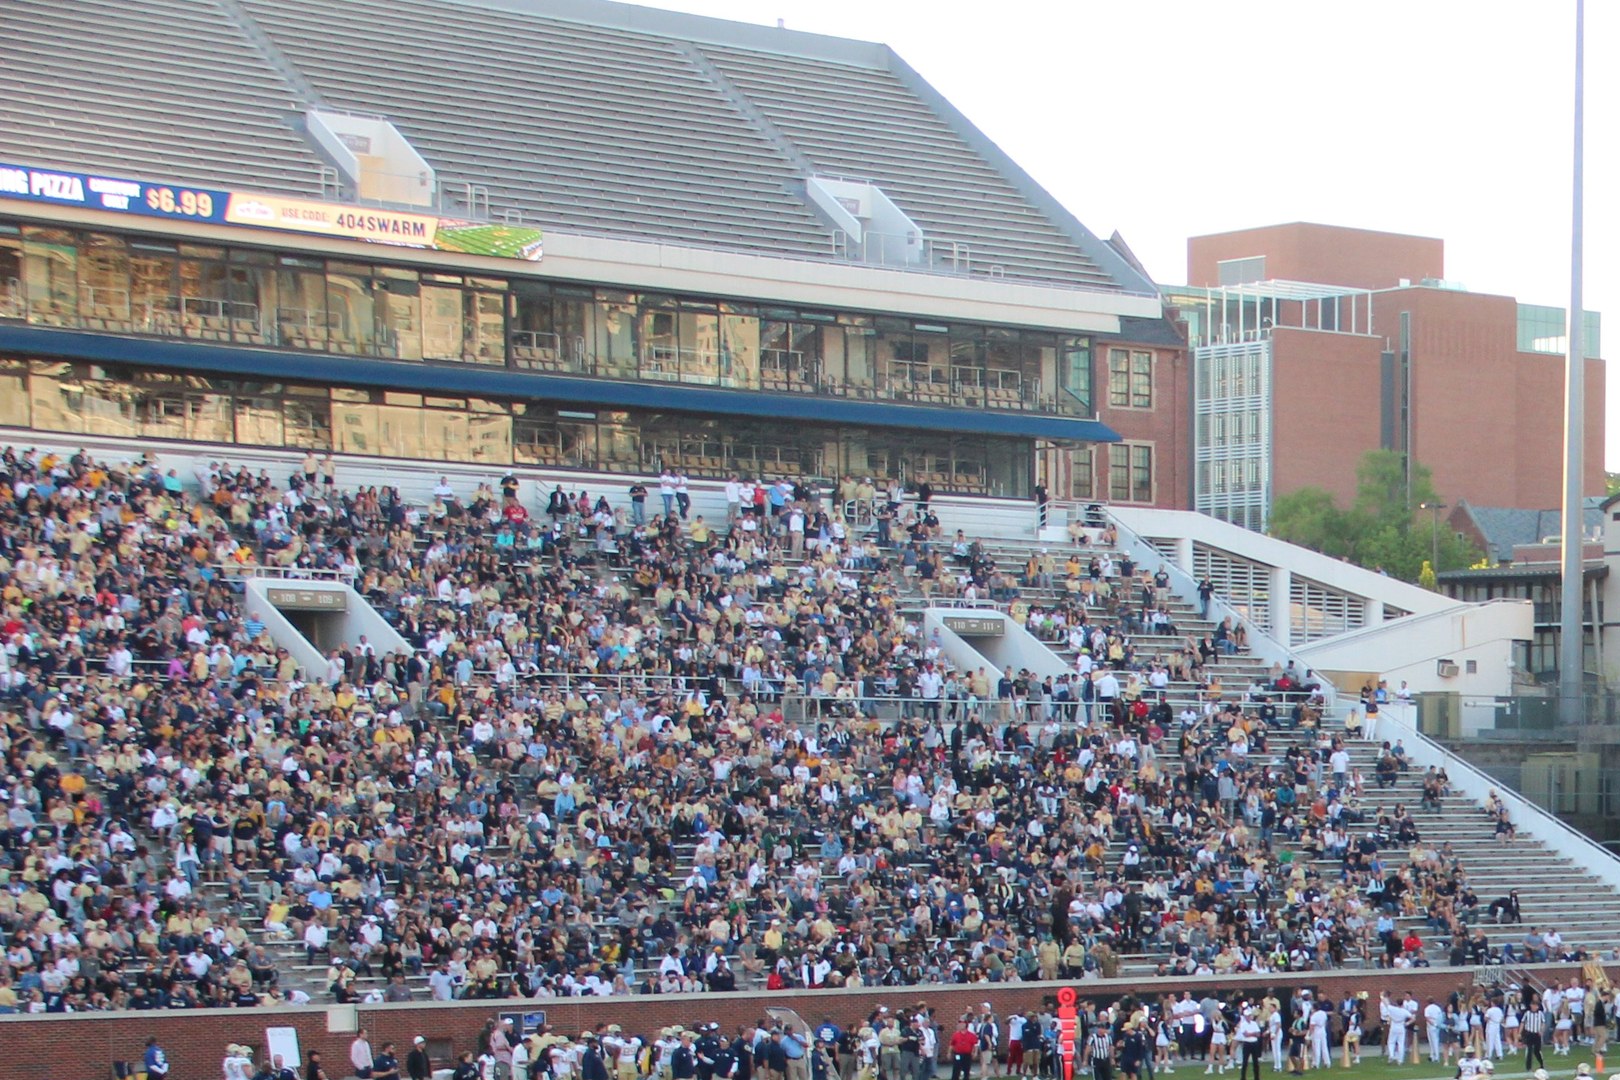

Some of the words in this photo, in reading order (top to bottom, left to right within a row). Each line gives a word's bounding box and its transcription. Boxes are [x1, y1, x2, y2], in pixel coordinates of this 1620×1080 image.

[29, 170, 85, 201] PIZZA
[147, 187, 213, 218] $6.99
[281, 207, 300, 219] USE
[336, 212, 426, 237] 404SWARM
